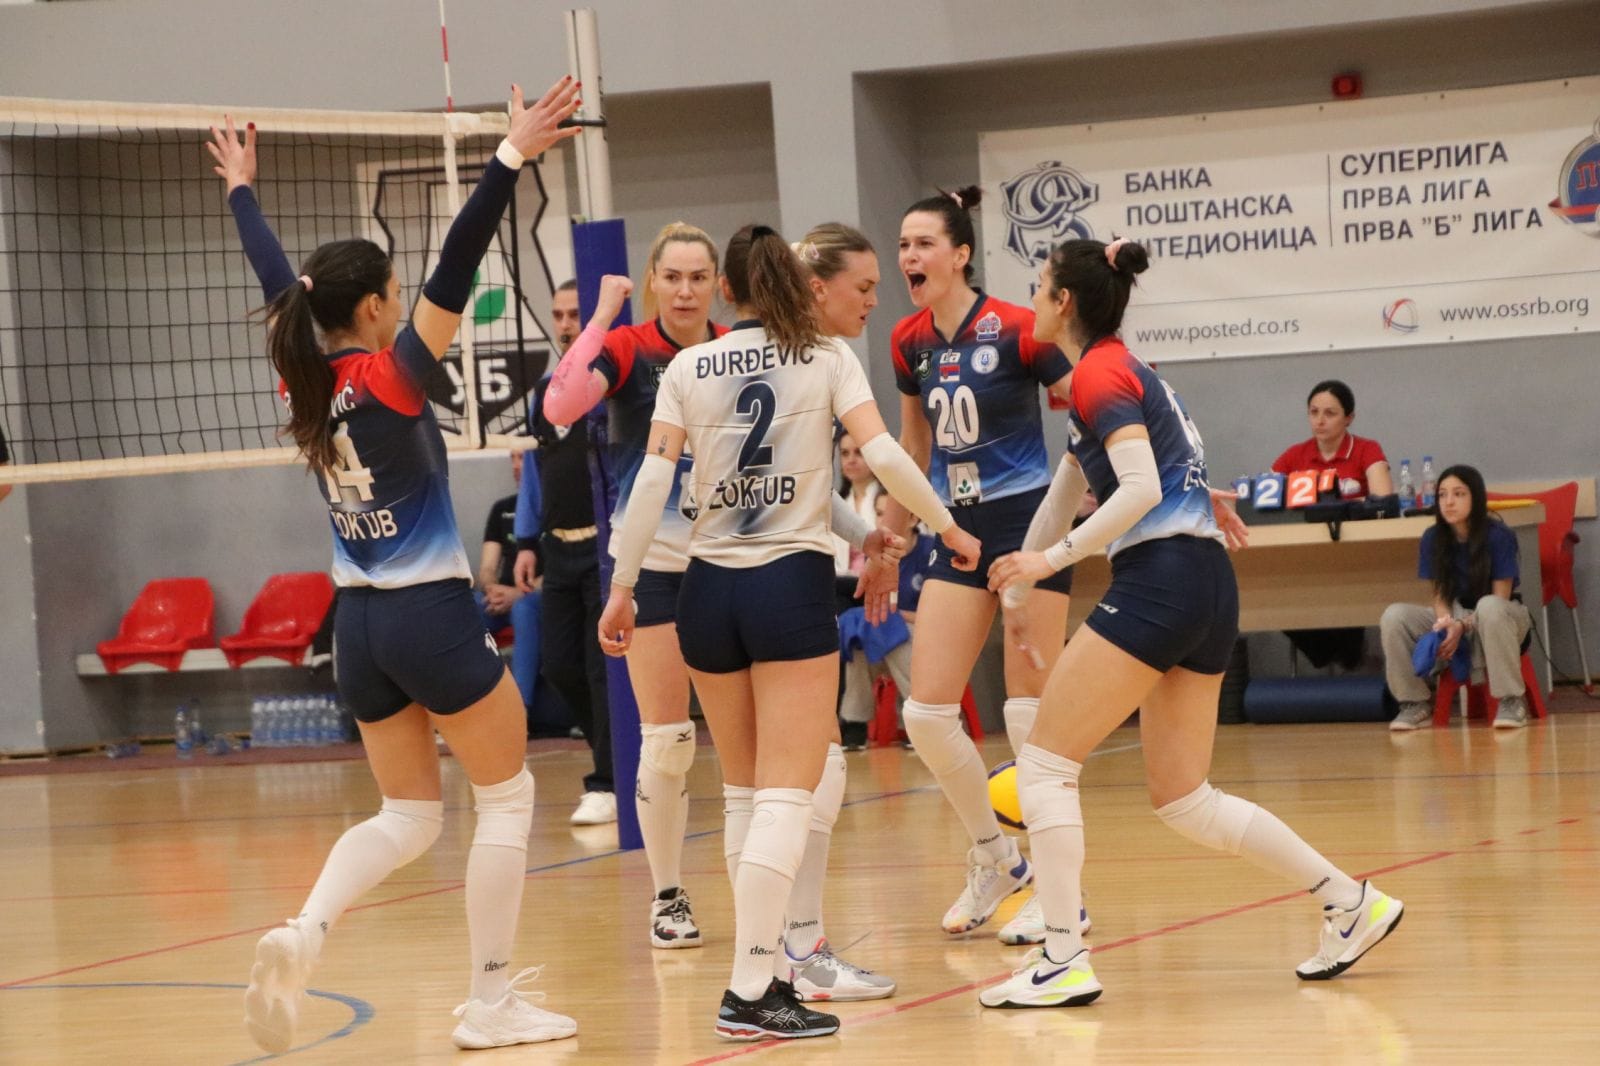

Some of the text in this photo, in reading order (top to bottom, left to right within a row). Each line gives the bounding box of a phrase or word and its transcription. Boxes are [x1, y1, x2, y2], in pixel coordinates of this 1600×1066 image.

[1340, 141, 1509, 177] СУПЕРЛИГА
[1125, 166, 1212, 193] БАНКА
[1343, 178, 1491, 210] ПРВА ЛИГА
[1126, 193, 1293, 226] ПОШТАНСКА
[1344, 219, 1413, 244] ПРВА
[1472, 207, 1543, 234] ЛИГА
[1131, 225, 1317, 260] ТЕДИОНИЦА
[1439, 295, 1590, 322] www.ossrb.org
[1135, 317, 1300, 343] www.posted.co.rs
[735, 380, 777, 473] 2
[928, 385, 980, 447] 20
[708, 475, 796, 511] ŽOK UB
[1237, 483, 1249, 499] 0
[1257, 478, 1279, 505] 2
[1291, 476, 1314, 504] 2
[364, 508, 398, 541] UB
